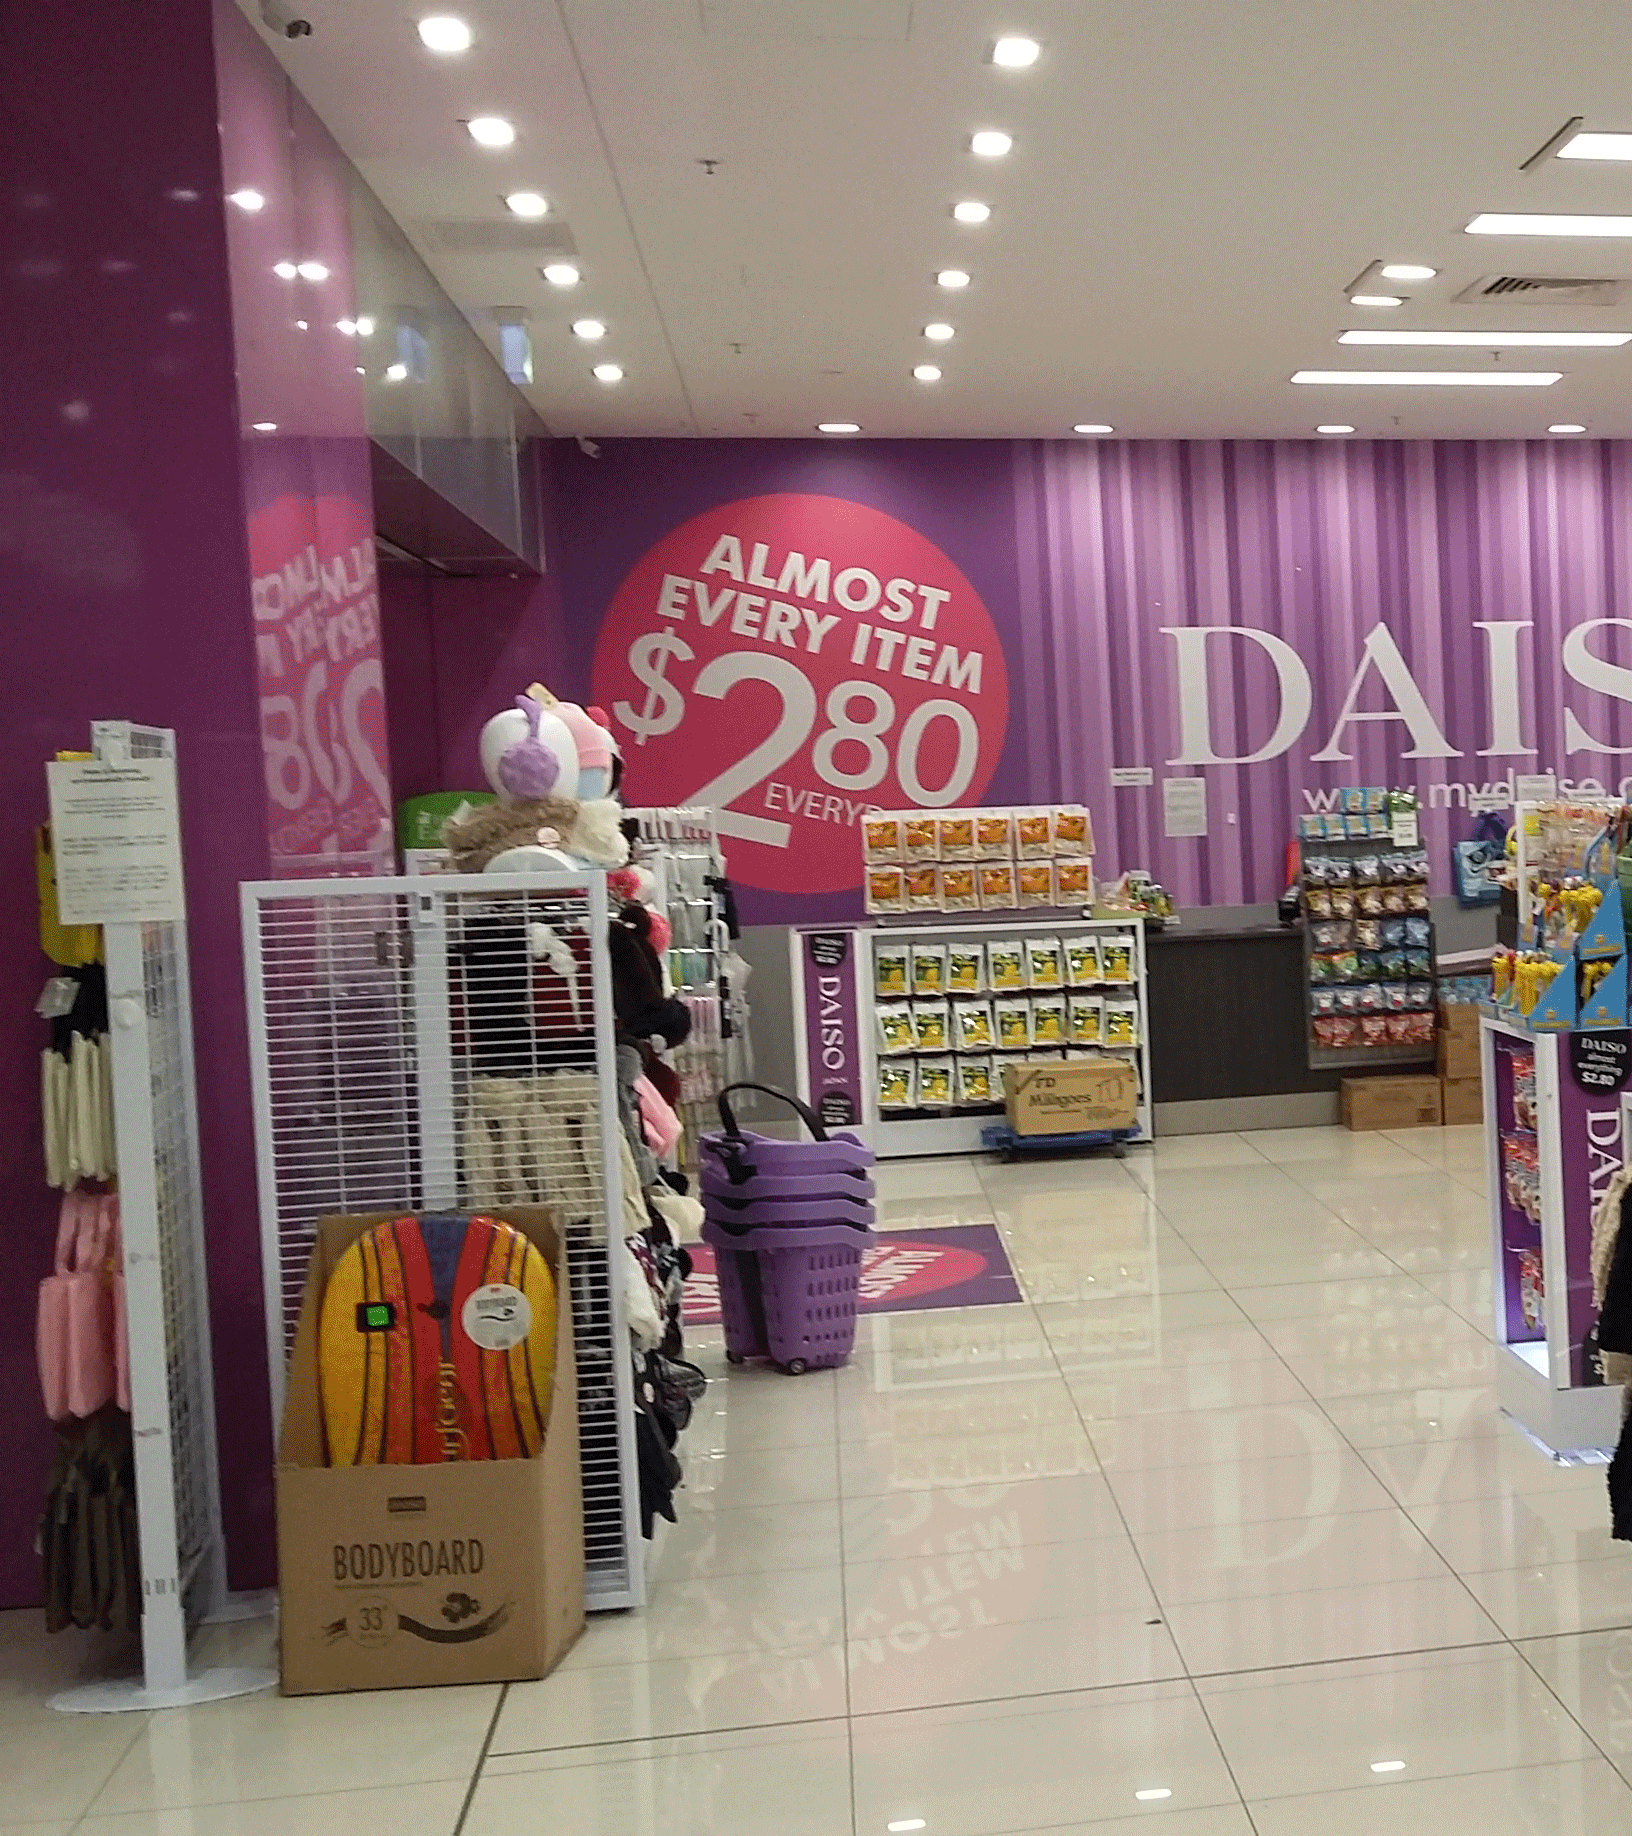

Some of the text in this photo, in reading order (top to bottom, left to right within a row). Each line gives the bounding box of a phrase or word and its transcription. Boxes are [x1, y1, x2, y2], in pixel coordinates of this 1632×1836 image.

[700, 534, 950, 630] ALMOST
[656, 574, 983, 695] EVERY ITEM
[818, 976, 846, 1070] DAISO
[1581, 1037, 1627, 1055] DAISO
[1582, 1071, 1615, 1087] $2.80
[333, 1537, 484, 1581] BODYBOARD
